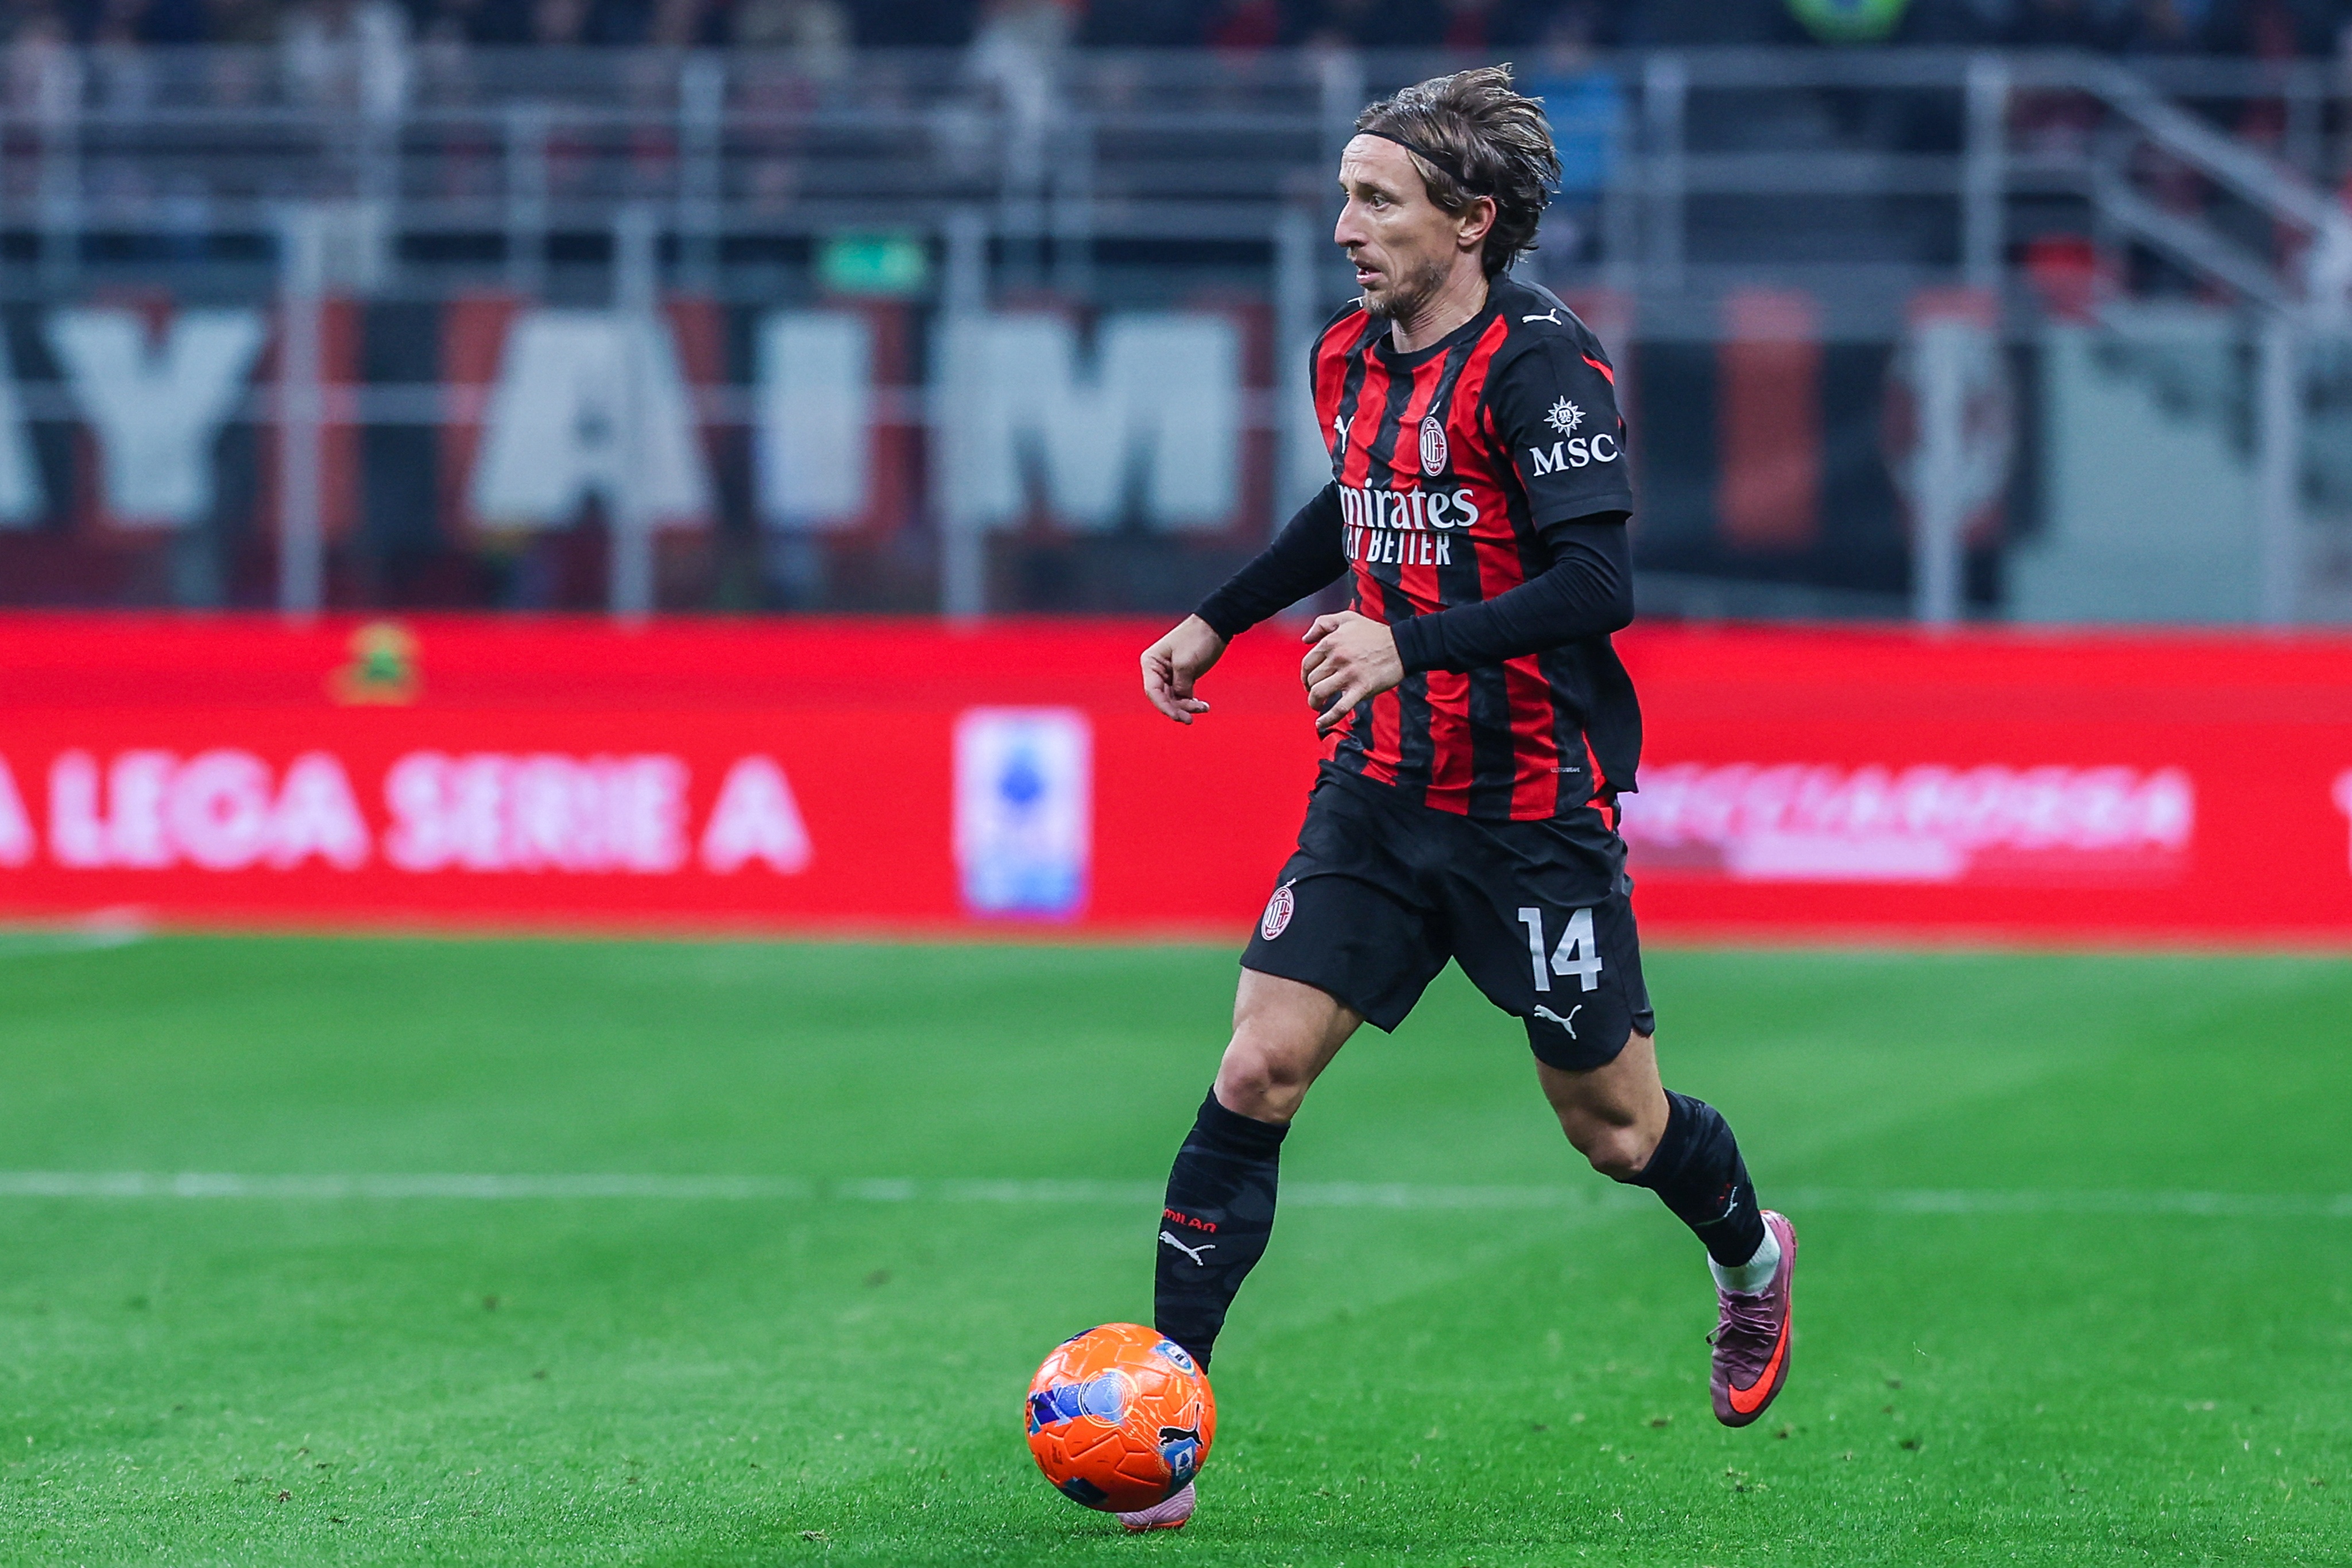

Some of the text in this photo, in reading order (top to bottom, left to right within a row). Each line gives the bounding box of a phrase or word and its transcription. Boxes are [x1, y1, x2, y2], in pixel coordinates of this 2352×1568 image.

[1529, 433, 1618, 477] MSC
[1337, 477, 1480, 530] mirates
[47, 748, 372, 873] LEGA
[696, 752, 815, 876] A
[1518, 907, 1604, 993] 14
